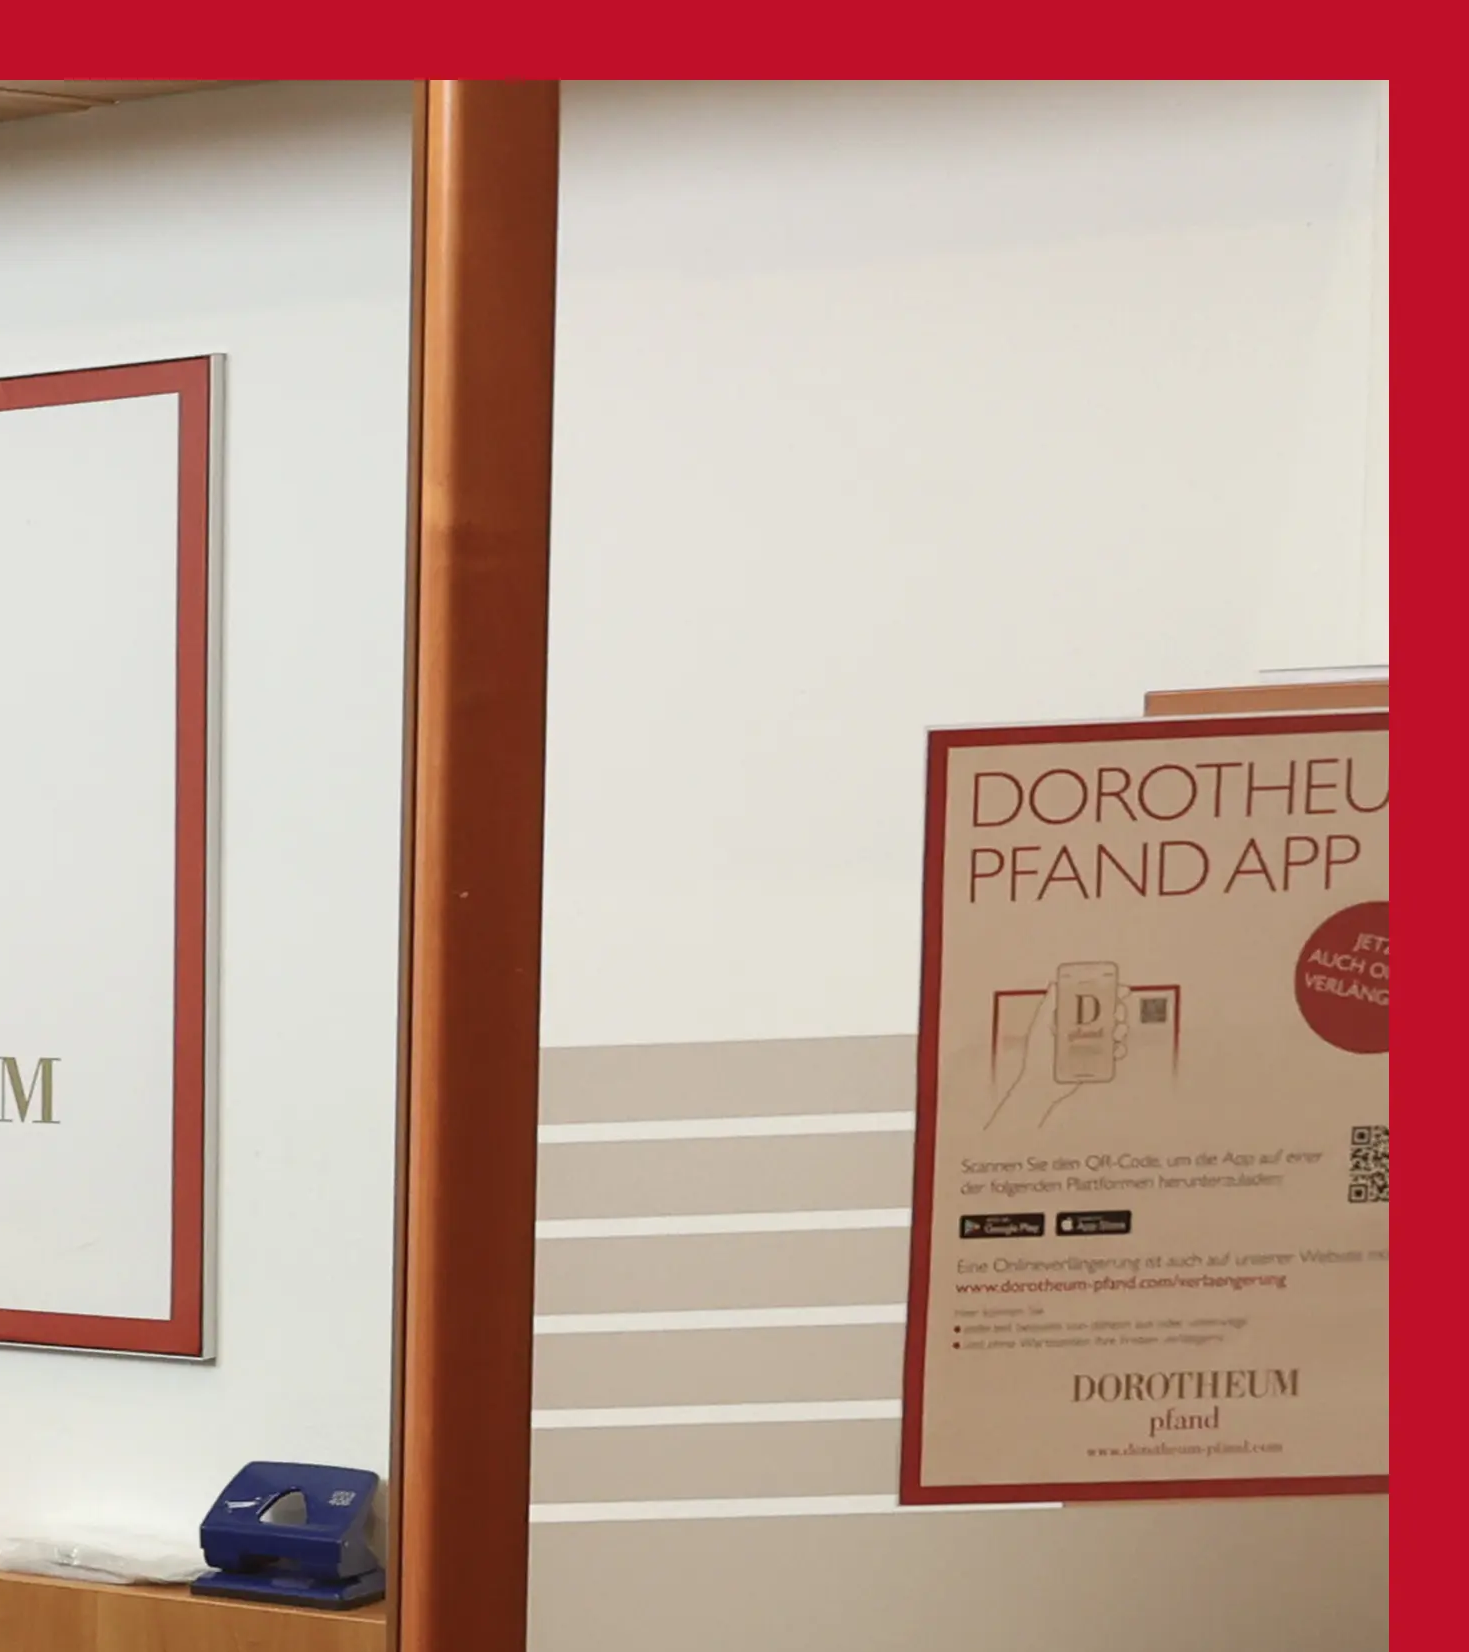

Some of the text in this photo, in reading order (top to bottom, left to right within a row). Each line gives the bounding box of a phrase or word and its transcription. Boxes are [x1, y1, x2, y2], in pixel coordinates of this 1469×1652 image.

[970, 835, 1362, 903] PFAND APP
[1307, 948, 1367, 974] AUCH
[1075, 994, 1101, 1025] D
[960, 1158, 1023, 1174] Scannen
[1026, 1156, 1049, 1172] Sie
[1052, 1157, 1081, 1171] den
[1166, 1156, 1192, 1168] um
[960, 1180, 986, 1196] der
[956, 1258, 989, 1275] Eine
[1071, 1368, 1300, 1403] DOROTHEUM
[1149, 1405, 1220, 1438] pfand
